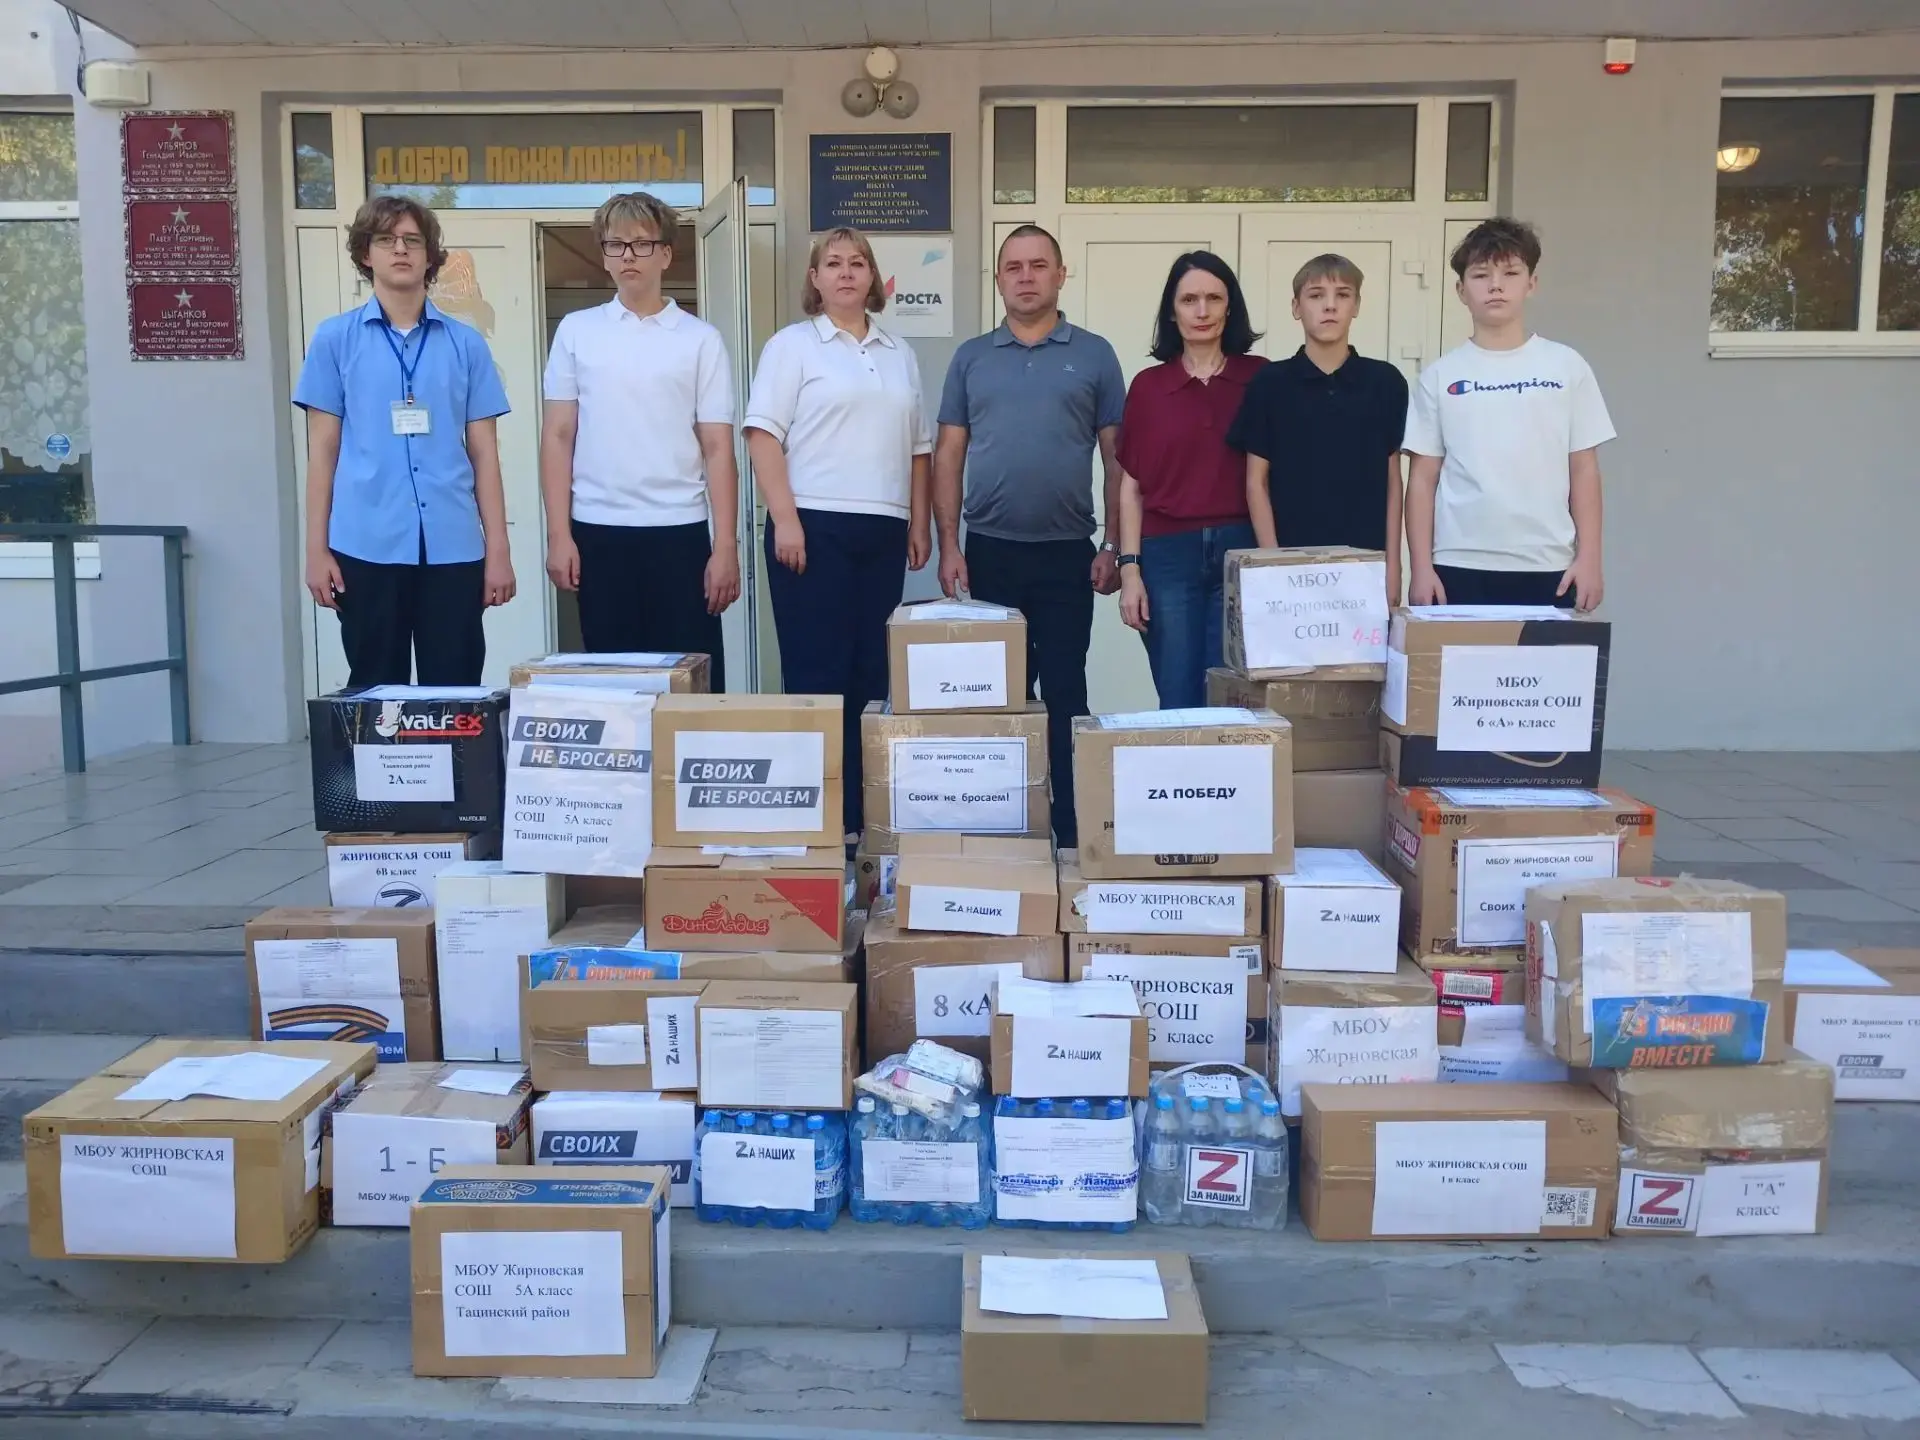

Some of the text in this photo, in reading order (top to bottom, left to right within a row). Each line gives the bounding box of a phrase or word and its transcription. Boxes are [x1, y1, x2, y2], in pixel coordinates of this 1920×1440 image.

[158, 141, 198, 150] УЛЬЯНОВ
[375, 128, 686, 184] ДОБРО ПОЖАЛОВАТЬ!
[895, 293, 942, 305] РОСТА
[161, 310, 206, 319] ЦЫГАНКОВ
[1447, 378, 1564, 395] Champion
[1287, 572, 1343, 588] МБОУ
[1265, 598, 1367, 616] Жирновская
[1295, 623, 1340, 639] СОШ
[960, 683, 992, 692] НАШИХ
[1496, 677, 1543, 688] МБОУ
[1452, 696, 1582, 709] Жирновская СОШ
[1477, 717, 1556, 729] 6 «А» класс
[521, 721, 590, 741] СВОИХ
[530, 749, 644, 769] НЕ БРОСАЕМ
[689, 764, 756, 780] СВОИХ
[388, 775, 404, 785] 2А
[699, 790, 810, 804] НЕ БРОСАЕМ
[908, 793, 1010, 803] Своих не бросаем!
[1173, 788, 1237, 800] ПОБЕДУ
[516, 795, 622, 810] МБОУ Жирновская
[515, 812, 613, 826] СОШ 5А класс
[1103, 820, 1114, 830] ра
[576, 834, 608, 844] район
[340, 851, 451, 862] ЖИРНОВСКАЯ СОШ
[1158, 855, 1170, 863] 15
[1513, 856, 1570, 865] ЖИРНОВСКАЯ
[1098, 893, 1236, 906] МБОУ ЖИРНОВСКАЯ
[966, 906, 1002, 916] НАШИХ
[1480, 902, 1515, 912] Своих
[1150, 909, 1183, 920] СОШ
[1343, 914, 1381, 923] НАШИХ
[1107, 974, 1234, 997] ирновская
[934, 993, 992, 1017] 8 «А
[1142, 1001, 1199, 1020] СОШ
[667, 1014, 678, 1043] НАШИХ
[1332, 1017, 1391, 1035] МБОУ
[1167, 1032, 1215, 1044] класс
[378, 1045, 404, 1054] аем
[1068, 1052, 1102, 1061] НАШИХ
[1307, 1047, 1418, 1067] Жирновская
[550, 1136, 620, 1153] СВОИХ
[74, 1144, 225, 1161] МБОУ ЖИРНОВСКАЯ
[758, 1148, 796, 1160] НАШИХ
[131, 1164, 167, 1176] СОШ
[1396, 1160, 1527, 1170] МБОУ ЖИРНОВСКАЯ СОШ
[1196, 1152, 1239, 1192] Z
[358, 1192, 410, 1202] МБОУ Жир
[1190, 1192, 1242, 1203] ЗА НАШИХ
[1638, 1179, 1684, 1216] Z
[1736, 1206, 1780, 1216] класс
[1631, 1216, 1682, 1226] ЗА НАШИХ
[454, 1264, 584, 1278] МБОУ Жирновская
[454, 1285, 573, 1296] СОШ 5А класс
[455, 1307, 570, 1320] Тацинский район
